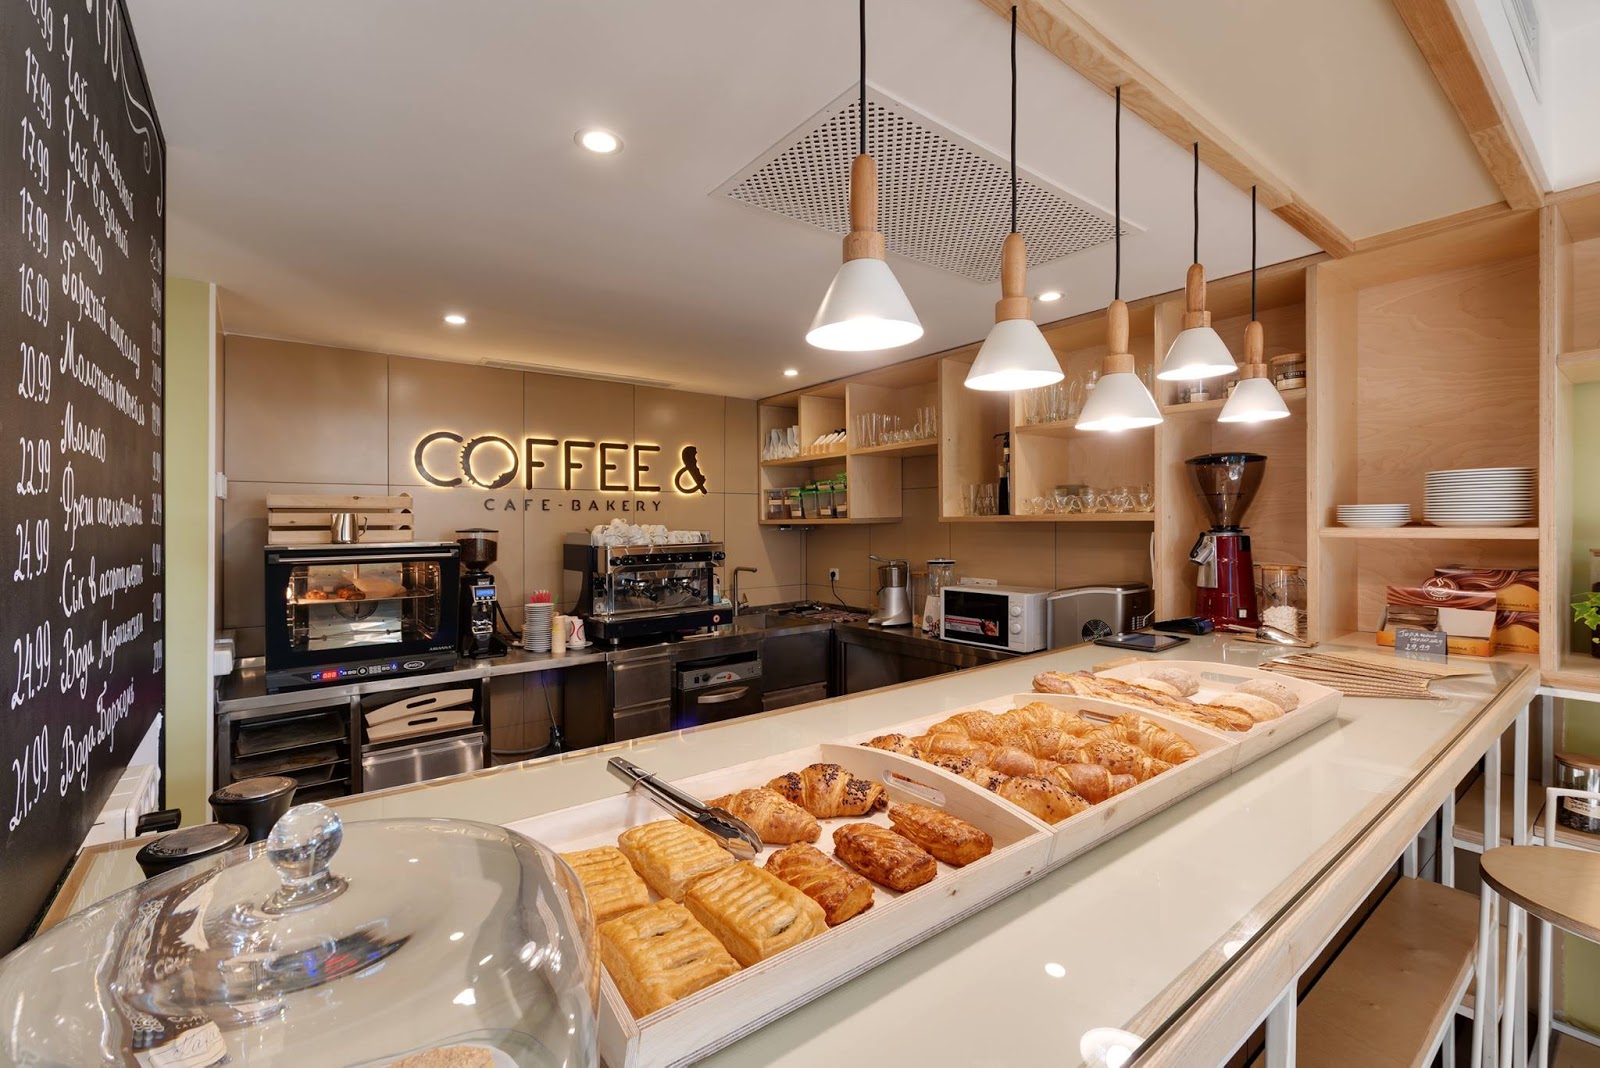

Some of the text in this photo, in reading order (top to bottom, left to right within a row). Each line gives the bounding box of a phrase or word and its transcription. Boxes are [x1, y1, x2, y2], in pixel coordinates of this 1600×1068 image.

[25, 47, 52, 129] 17.99
[64, 13, 89, 121] Чай
[21, 116, 49, 195] 17.99
[64, 95, 89, 188] Чай
[20, 187, 49, 258] 17.99
[65, 169, 103, 275] Какао
[19, 263, 49, 327] 16.99
[18, 342, 51, 404] 20.99
[16, 437, 51, 495] 22.99
[60, 401, 106, 463] Молоко
[414, 431, 708, 495] COFFEE &
[62, 461, 94, 551] Фреш
[13, 518, 50, 582] 24.99
[62, 558, 85, 618] Сік
[11, 620, 50, 709] 24.99
[60, 627, 95, 700] Вода
[9, 724, 49, 832] 21.99
[60, 725, 96, 797] Вода
